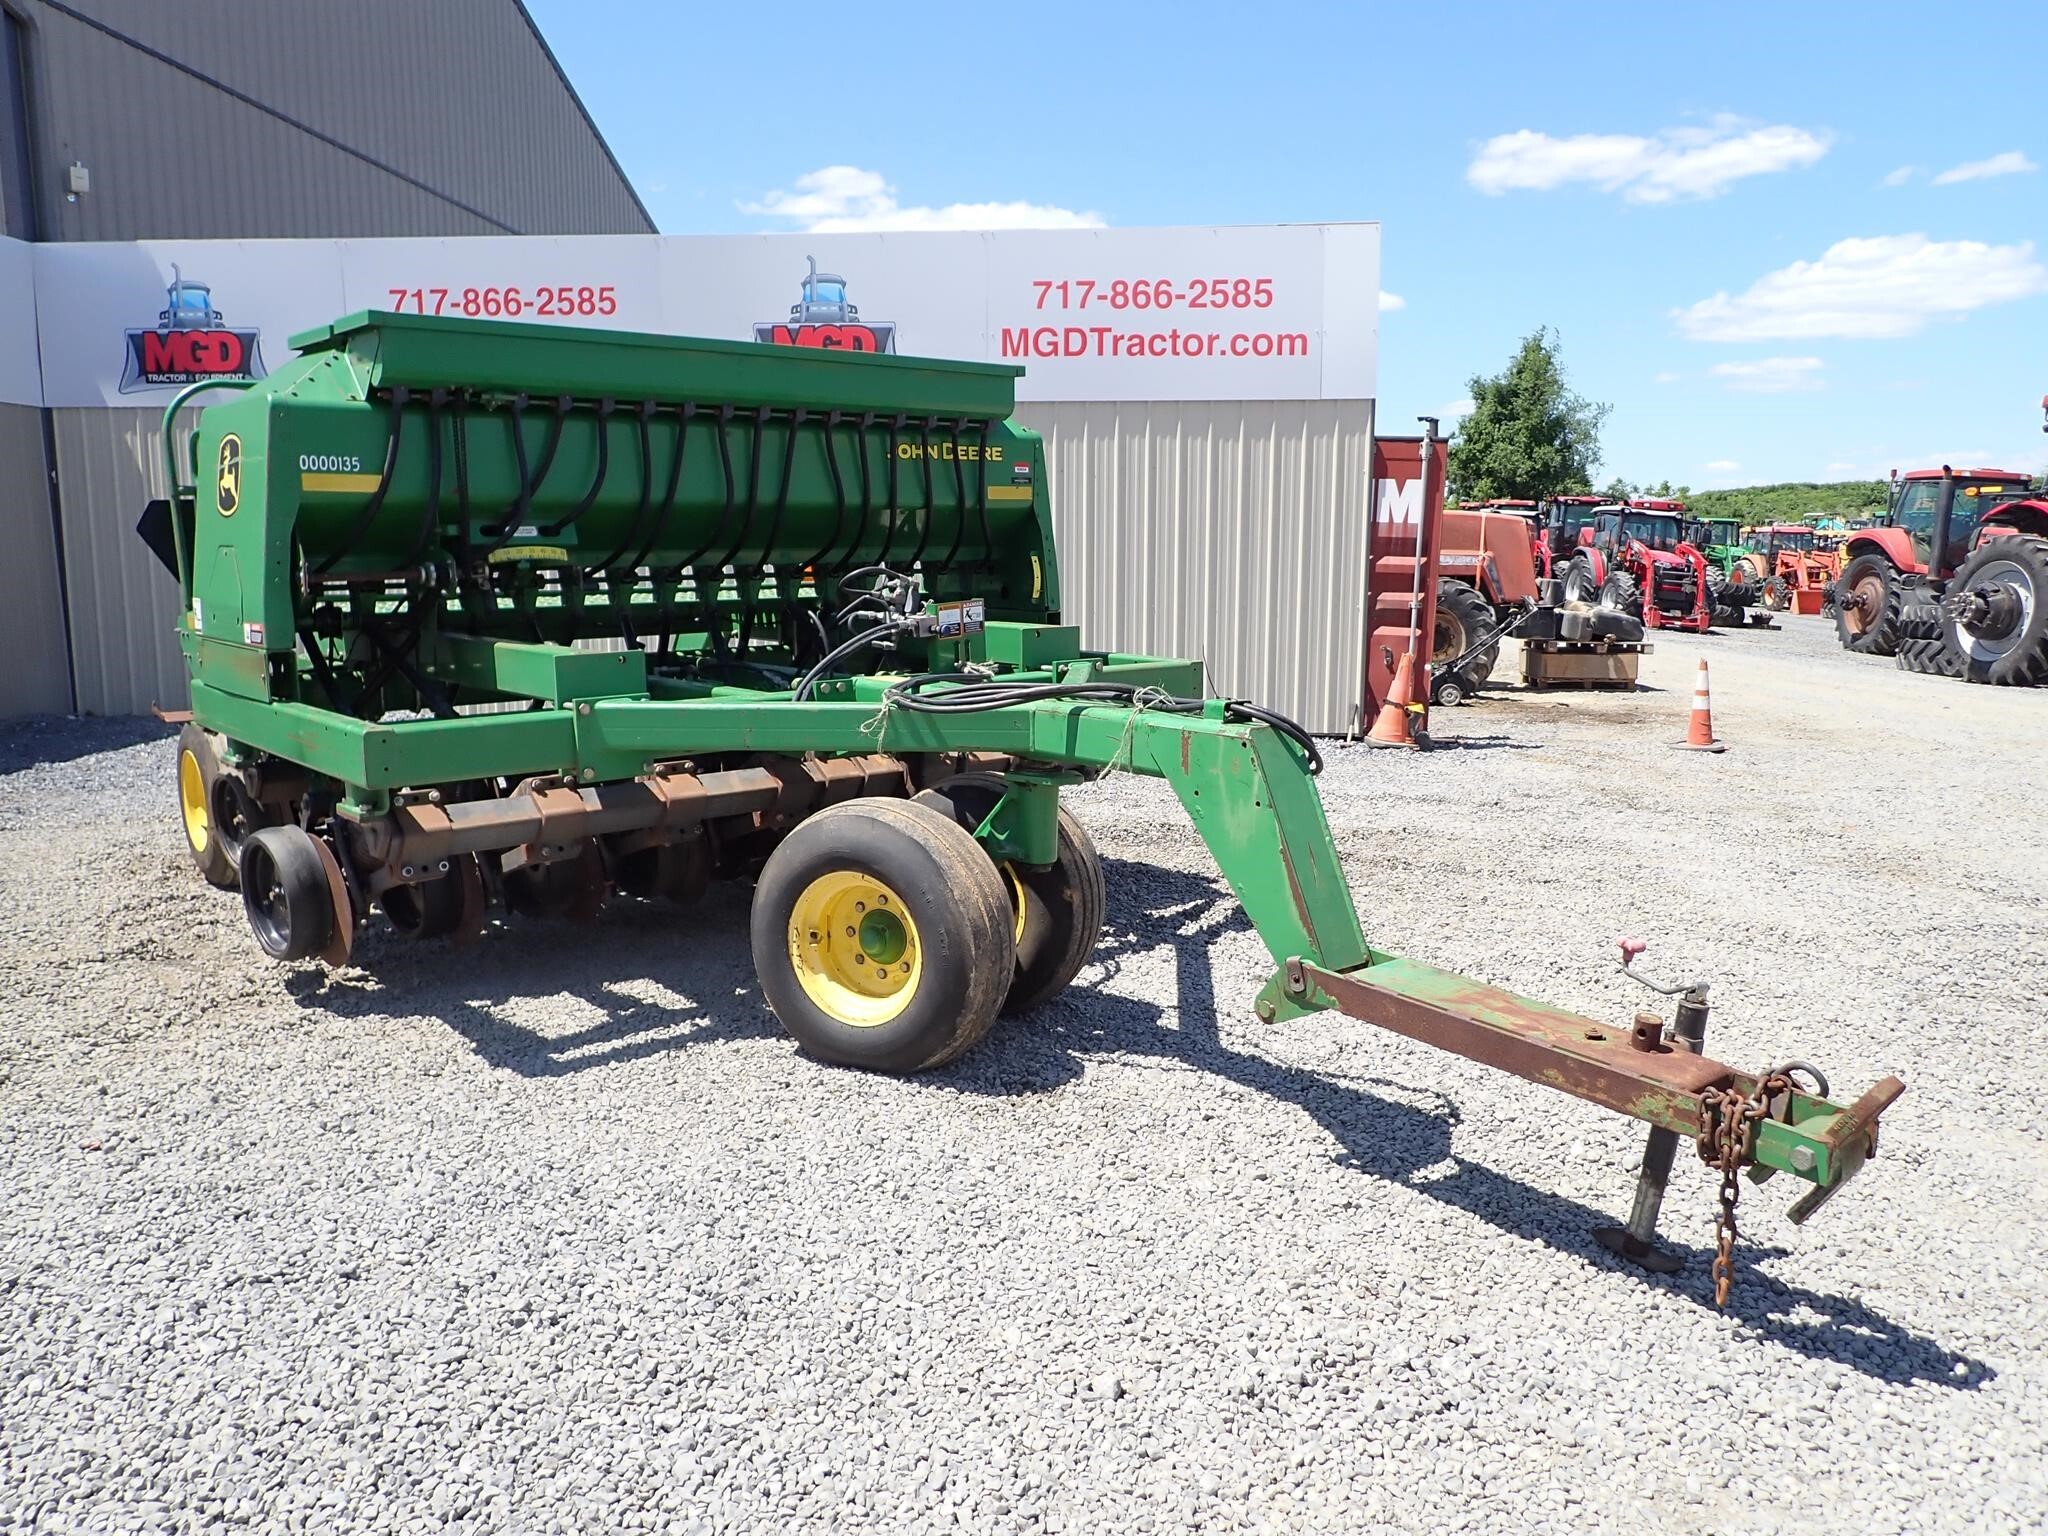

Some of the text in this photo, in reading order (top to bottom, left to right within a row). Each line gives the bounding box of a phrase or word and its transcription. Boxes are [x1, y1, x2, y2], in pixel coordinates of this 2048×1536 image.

[389, 287, 617, 316] 717-866-2585
[1033, 278, 1274, 309] 717-866-2585
[143, 330, 243, 373] MGD
[1001, 326, 1308, 357] MGDTractor.com
[147, 373, 187, 382] TRACTOR
[299, 454, 360, 472] 0000135
[887, 443, 939, 460] OHN
